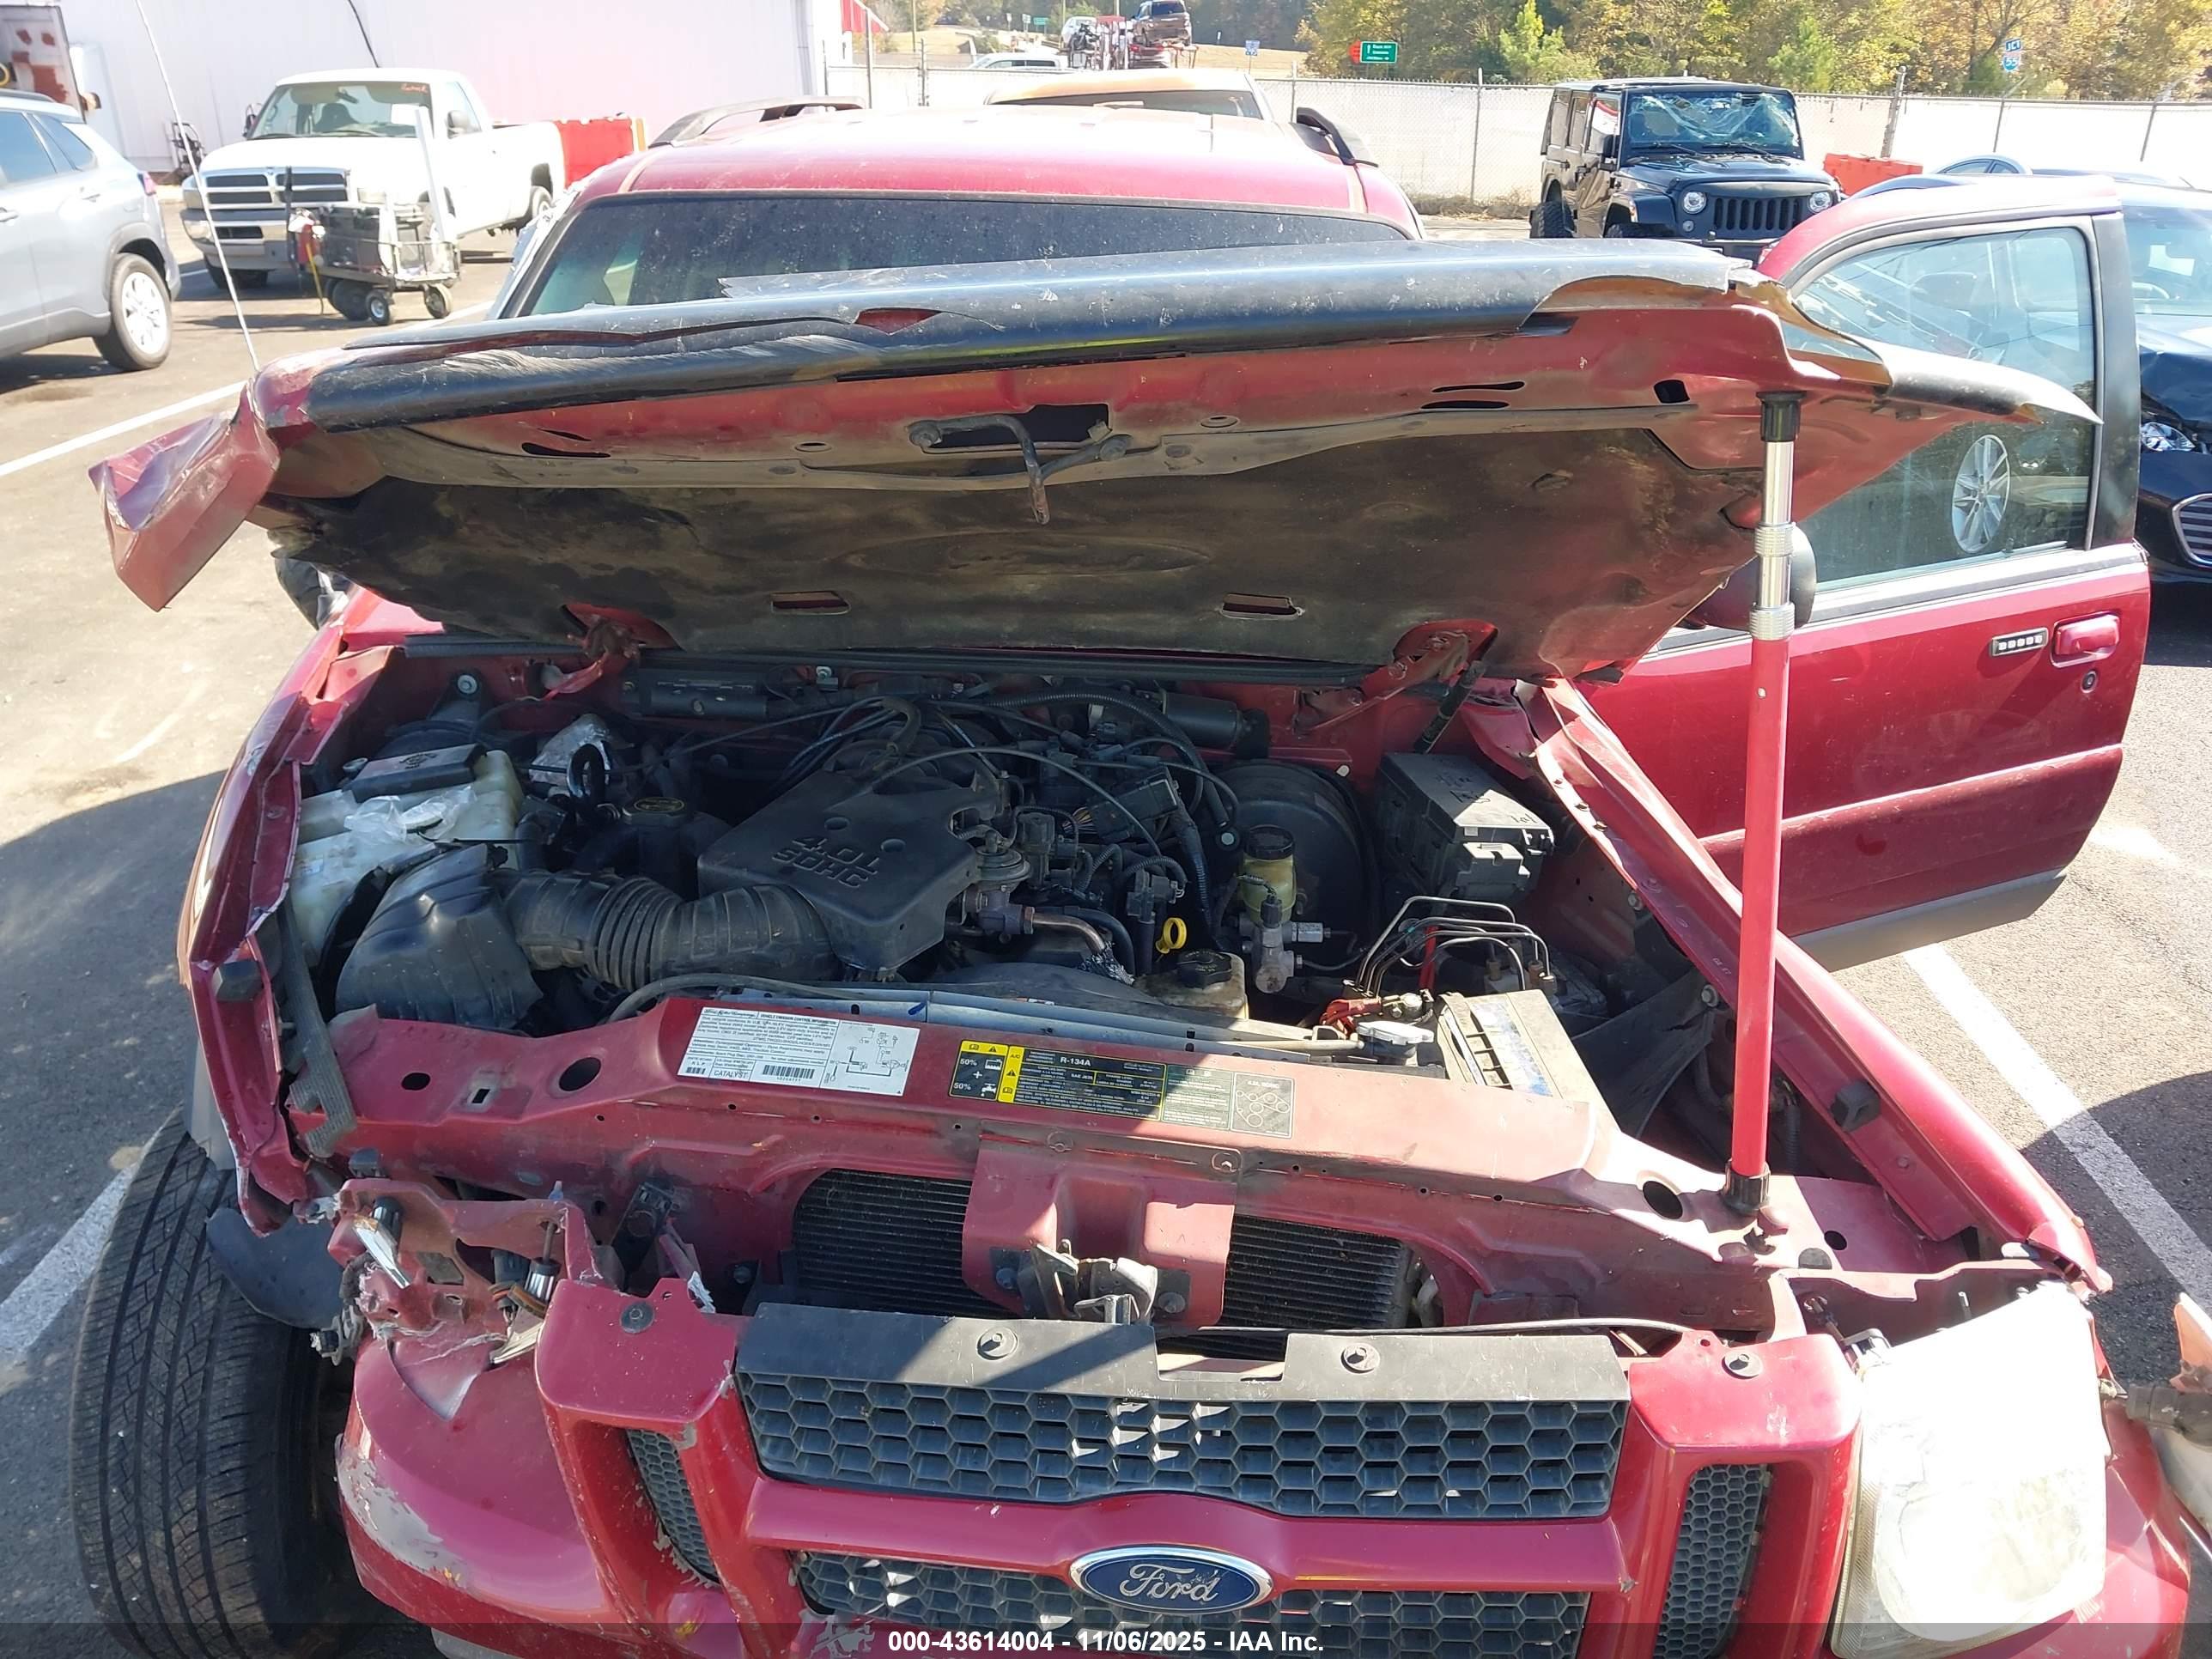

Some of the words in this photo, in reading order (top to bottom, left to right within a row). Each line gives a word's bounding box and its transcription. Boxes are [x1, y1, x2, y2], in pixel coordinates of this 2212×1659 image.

[2006, 40, 2021, 52] JCT
[2005, 57, 2019, 67] 55
[792, 837, 880, 875] 4.0L
[771, 848, 868, 888] SOHC
[1060, 1056, 1091, 1066] R-134A
[714, 1070, 749, 1079] CATALYST
[953, 1082, 971, 1091] 50%
[1119, 1563, 1220, 1602] Ford
